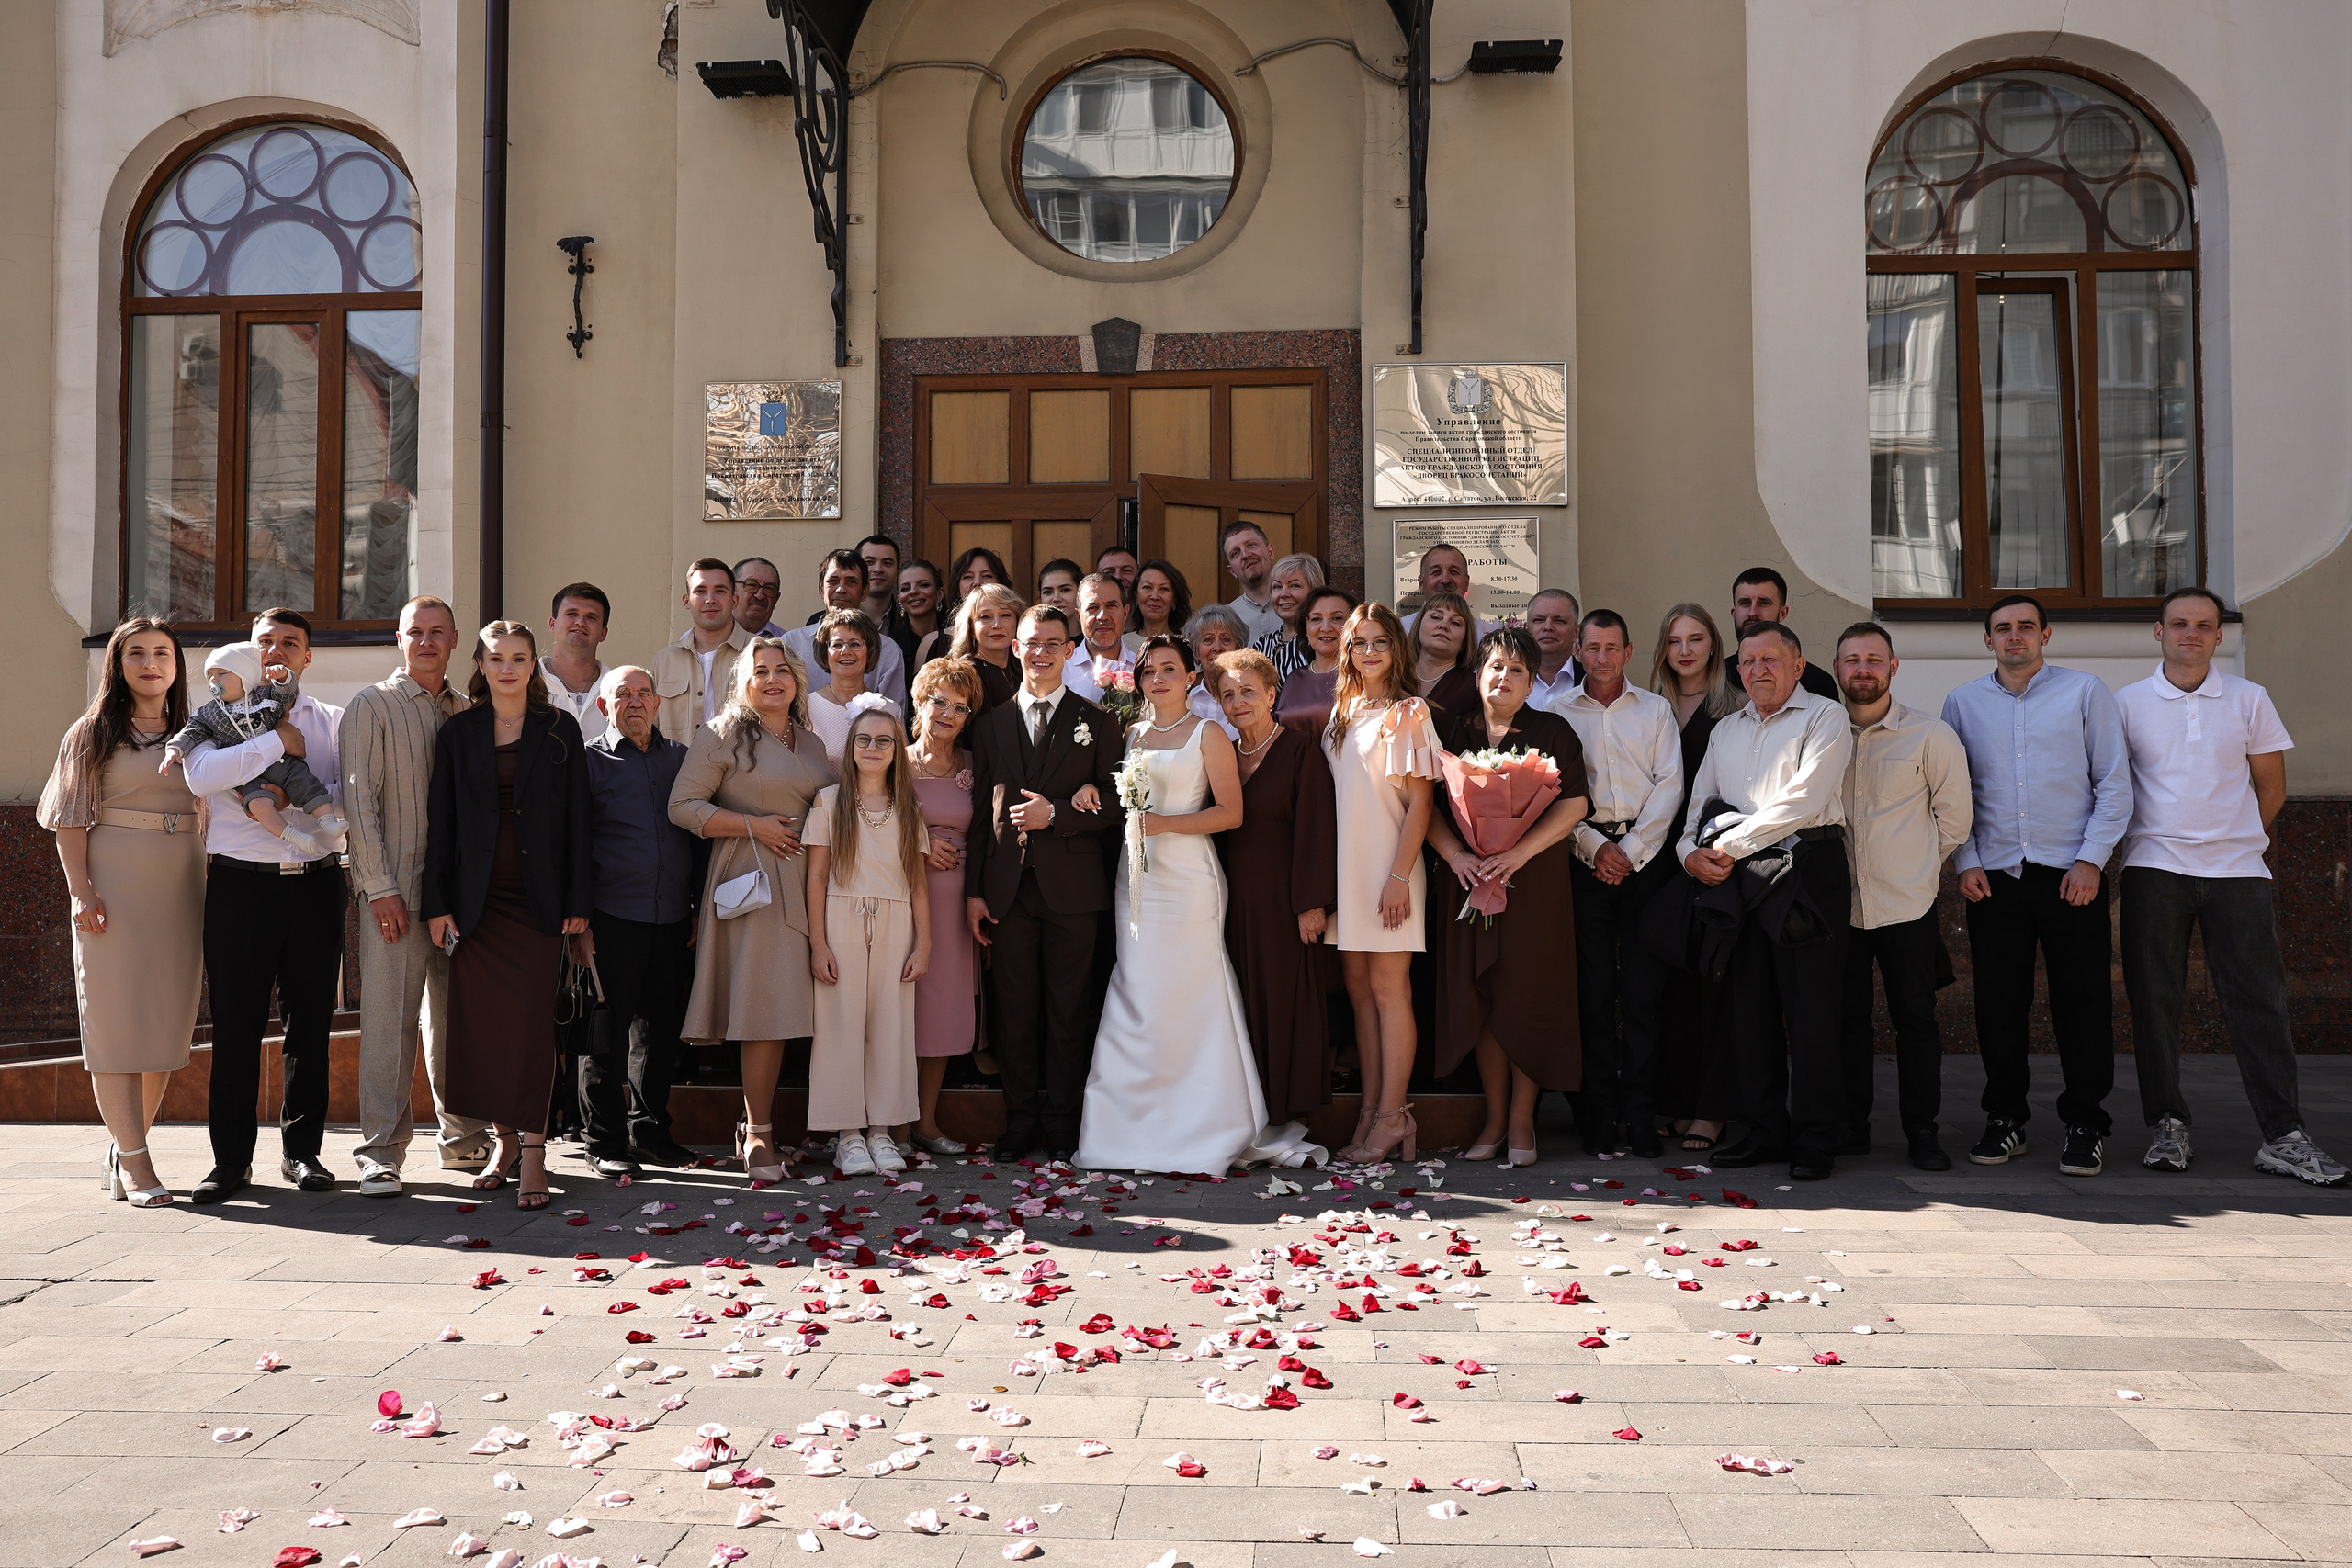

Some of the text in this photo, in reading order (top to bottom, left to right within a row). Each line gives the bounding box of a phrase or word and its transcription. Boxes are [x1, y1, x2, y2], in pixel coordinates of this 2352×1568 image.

[1437, 418, 1501, 427] Управление
[1407, 447, 1505, 456] СПЕЦИАЛИЗИРОВАННЫЙ
[1403, 454, 1481, 463] ГОСУДАРСТВЕННОЙ
